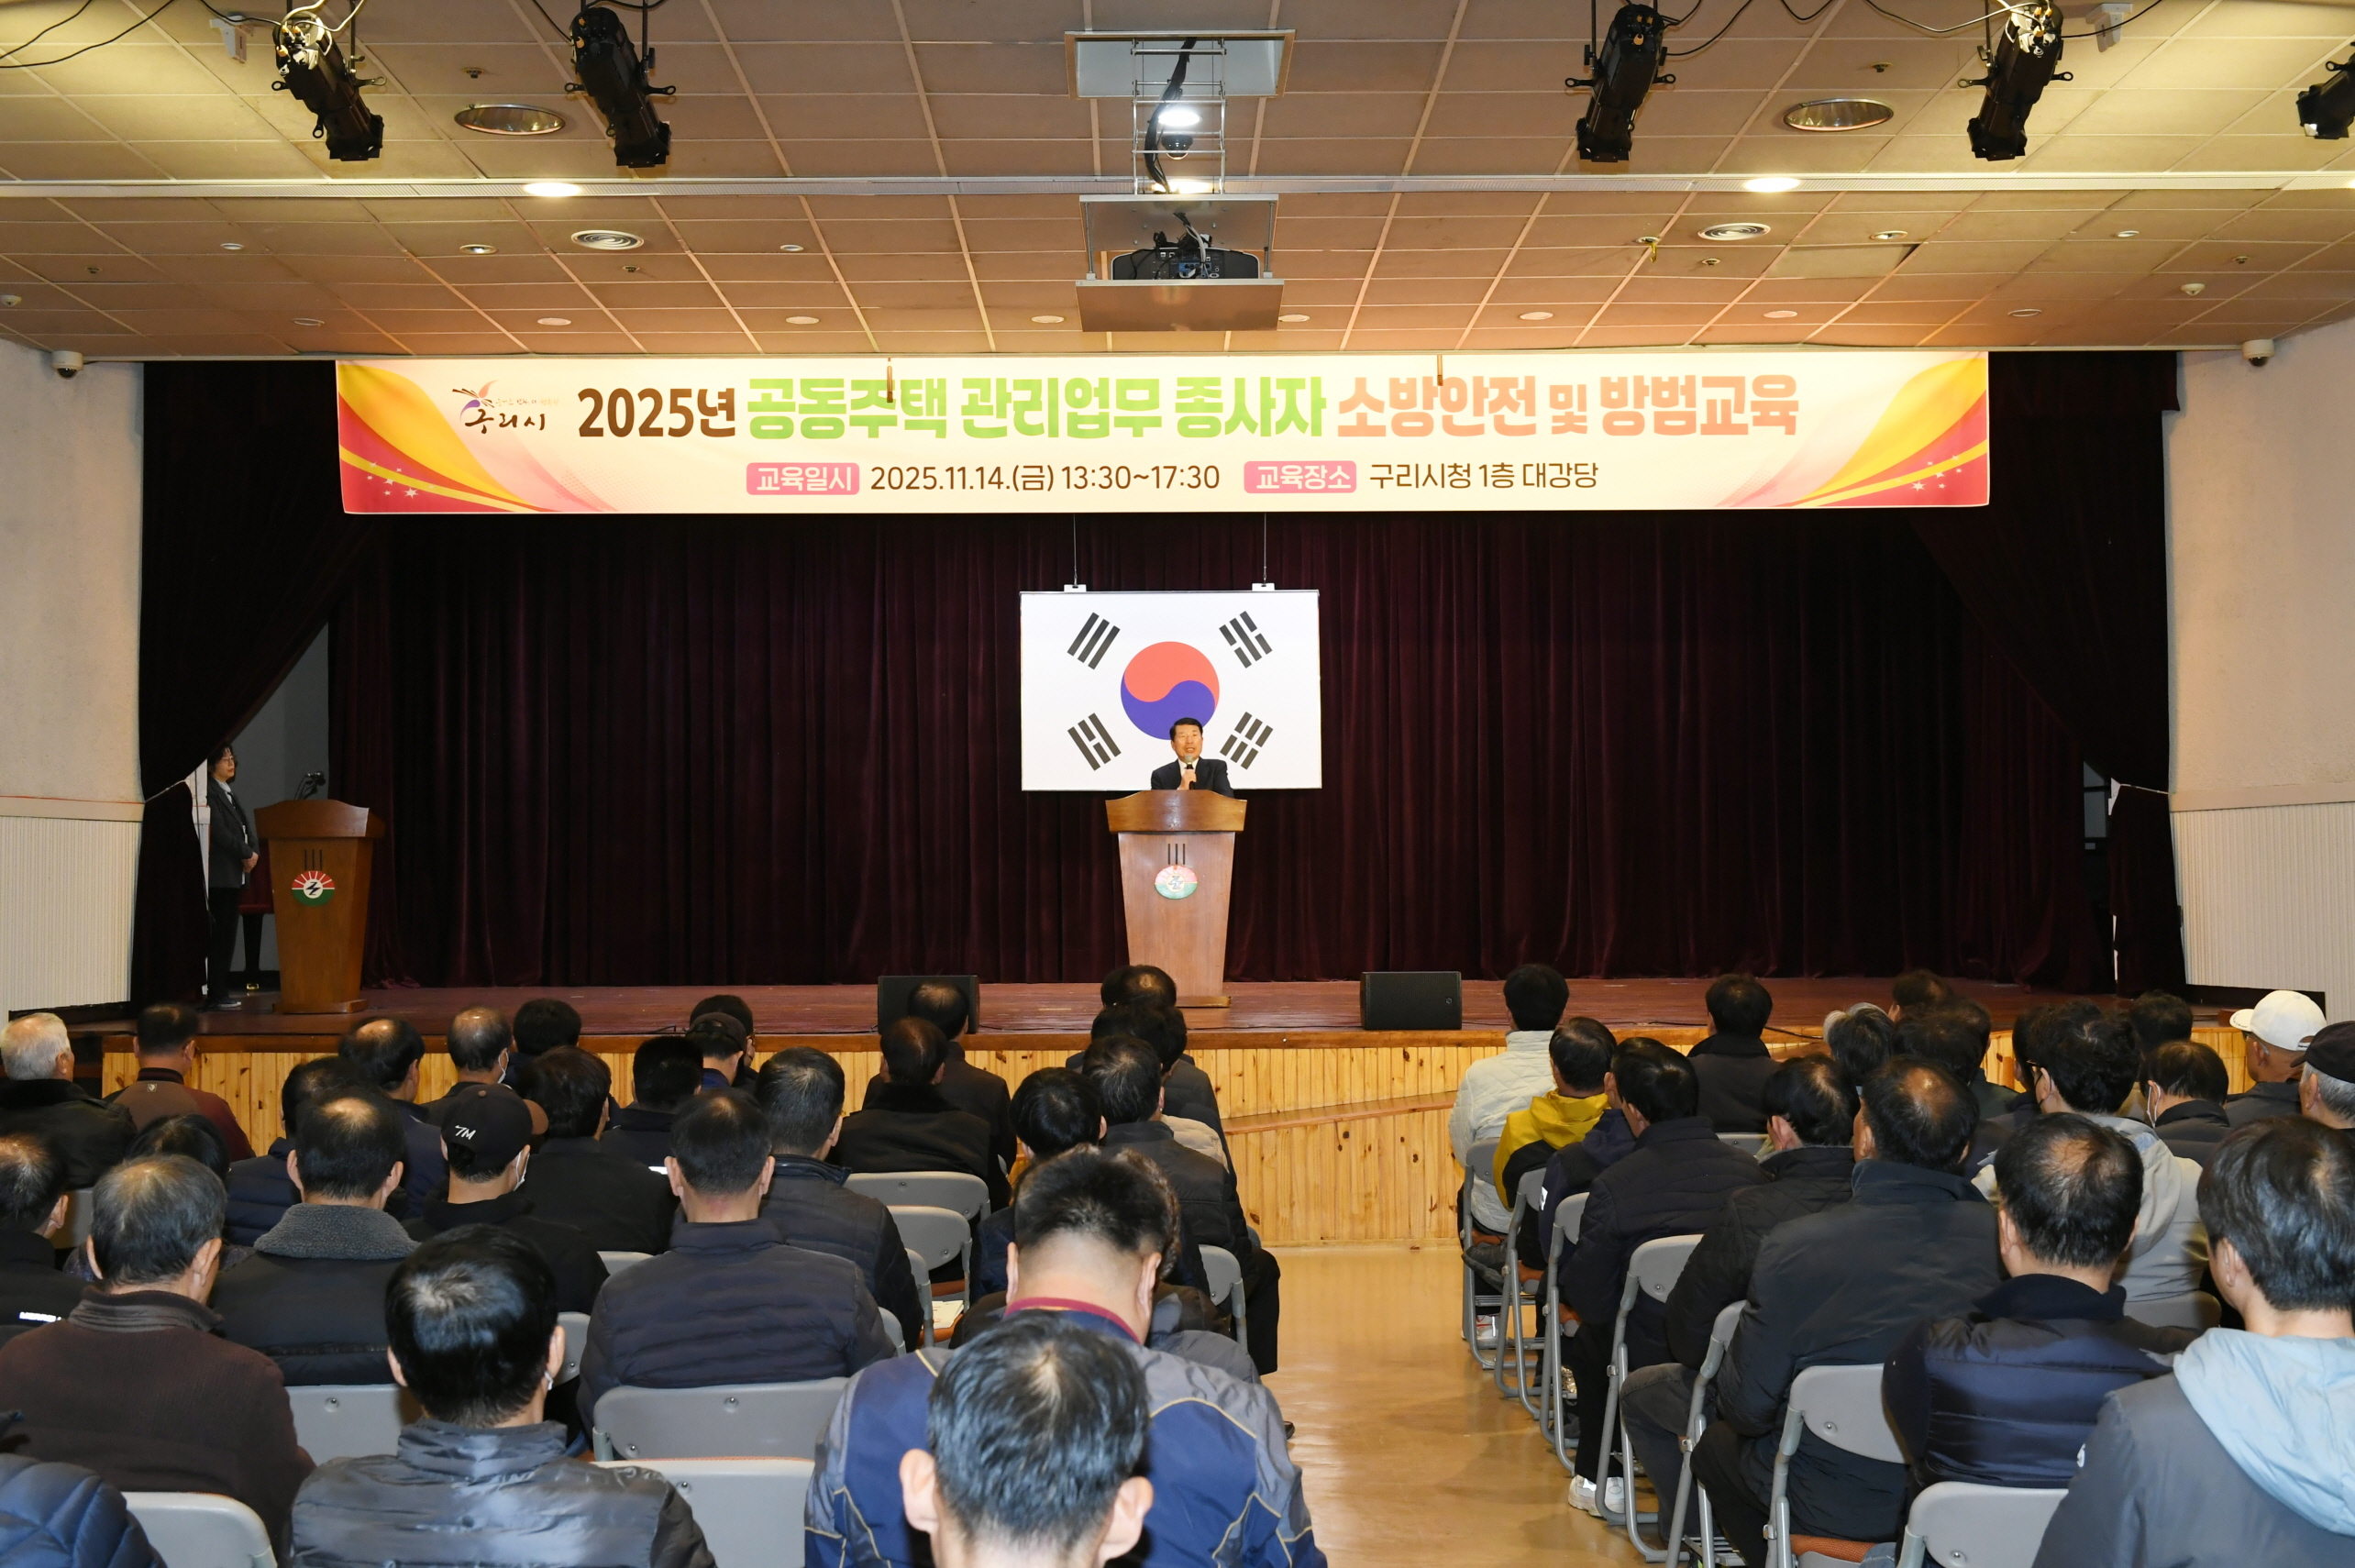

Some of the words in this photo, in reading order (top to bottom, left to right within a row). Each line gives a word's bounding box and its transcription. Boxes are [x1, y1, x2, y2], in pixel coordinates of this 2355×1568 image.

[578, 388, 735, 437] 2025년
[747, 378, 947, 439] 공동주택
[961, 378, 1162, 439] 관리업무
[1175, 377, 1327, 437] 종사자
[1338, 376, 1536, 436] 소방안전
[1549, 384, 1587, 435] 및
[1600, 375, 1798, 436] 방범교육
[465, 409, 546, 435] 구리시
[757, 467, 851, 491] 교육일시
[871, 465, 1054, 491] 2025.11.14.(금)
[1062, 465, 1220, 490] 13:30~17:30
[1256, 465, 1351, 490] 교육장소
[1370, 463, 1471, 489] 구리시청
[1479, 462, 1515, 489] 1층
[1523, 462, 1598, 488] 대강당
